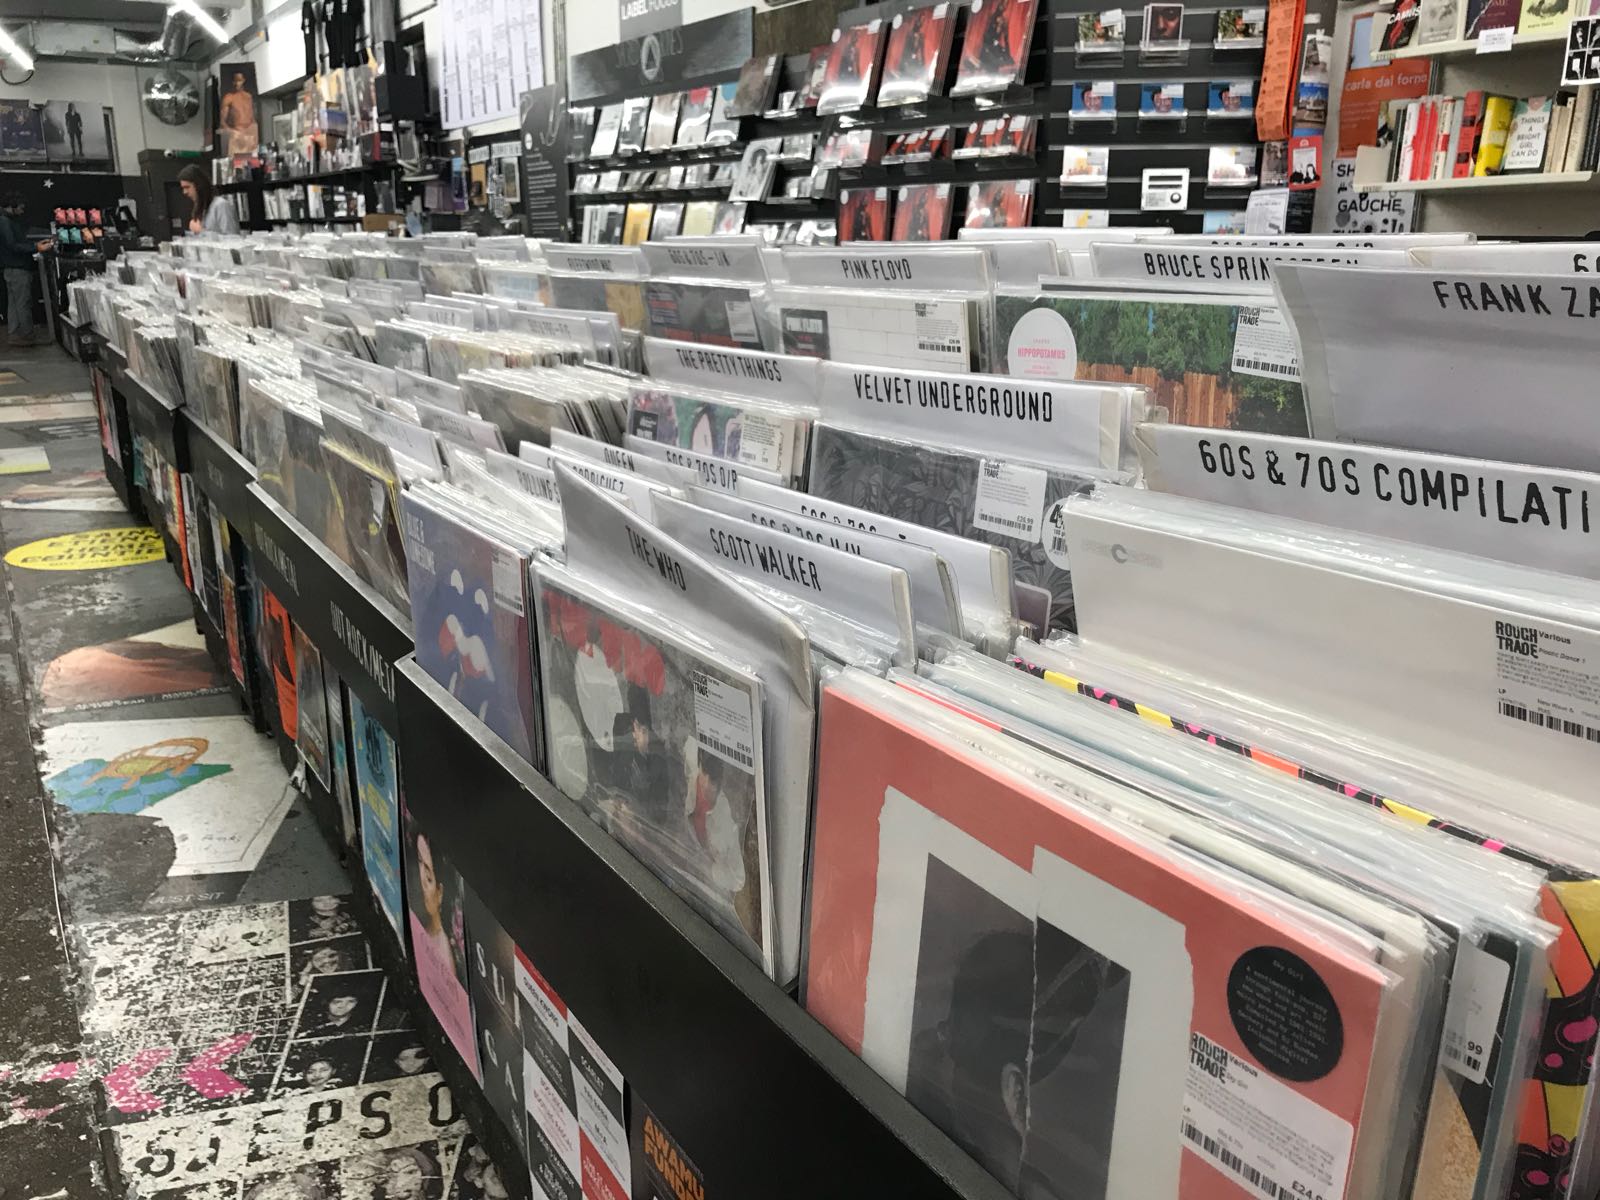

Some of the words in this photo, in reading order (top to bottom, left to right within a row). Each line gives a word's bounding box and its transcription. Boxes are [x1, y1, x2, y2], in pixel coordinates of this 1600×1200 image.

[1344, 76, 1370, 92] carla
[1375, 73, 1393, 88] dal
[1397, 71, 1428, 86] forno
[1520, 116, 1545, 124] THINGS
[1517, 133, 1540, 141] BRIGHT
[1337, 199, 1403, 213] GAUCHE
[841, 259, 870, 279] PINK
[872, 258, 912, 280] FLOYD
[1144, 252, 1205, 278] BRUCE
[1433, 280, 1551, 315] FRANK
[1239, 315, 1259, 326] TRADE
[676, 349, 698, 370] THE
[698, 351, 738, 376] PRETTY
[738, 356, 782, 382] THINGS
[854, 373, 912, 406] VELVET
[917, 380, 1053, 422] UNDERGROUND
[604, 448, 635, 472] QUEEN
[719, 466, 738, 490] O/P
[1198, 439, 1256, 480] 60S
[1265, 449, 1287, 486] &
[1296, 452, 1361, 496] 70S
[1373, 462, 1591, 533] COMPILATI
[625, 524, 655, 569] THE
[653, 547, 687, 591] WHO
[709, 527, 755, 567] SCOTT
[755, 543, 822, 592] WALKER
[1496, 620, 1538, 644] ROUGH
[1539, 631, 1571, 644] Various
[1496, 635, 1538, 659] TRADE
[1191, 1033, 1228, 1066] ROUGH
[1190, 1048, 1226, 1084] TRADE
[1229, 1056, 1258, 1077] Various
